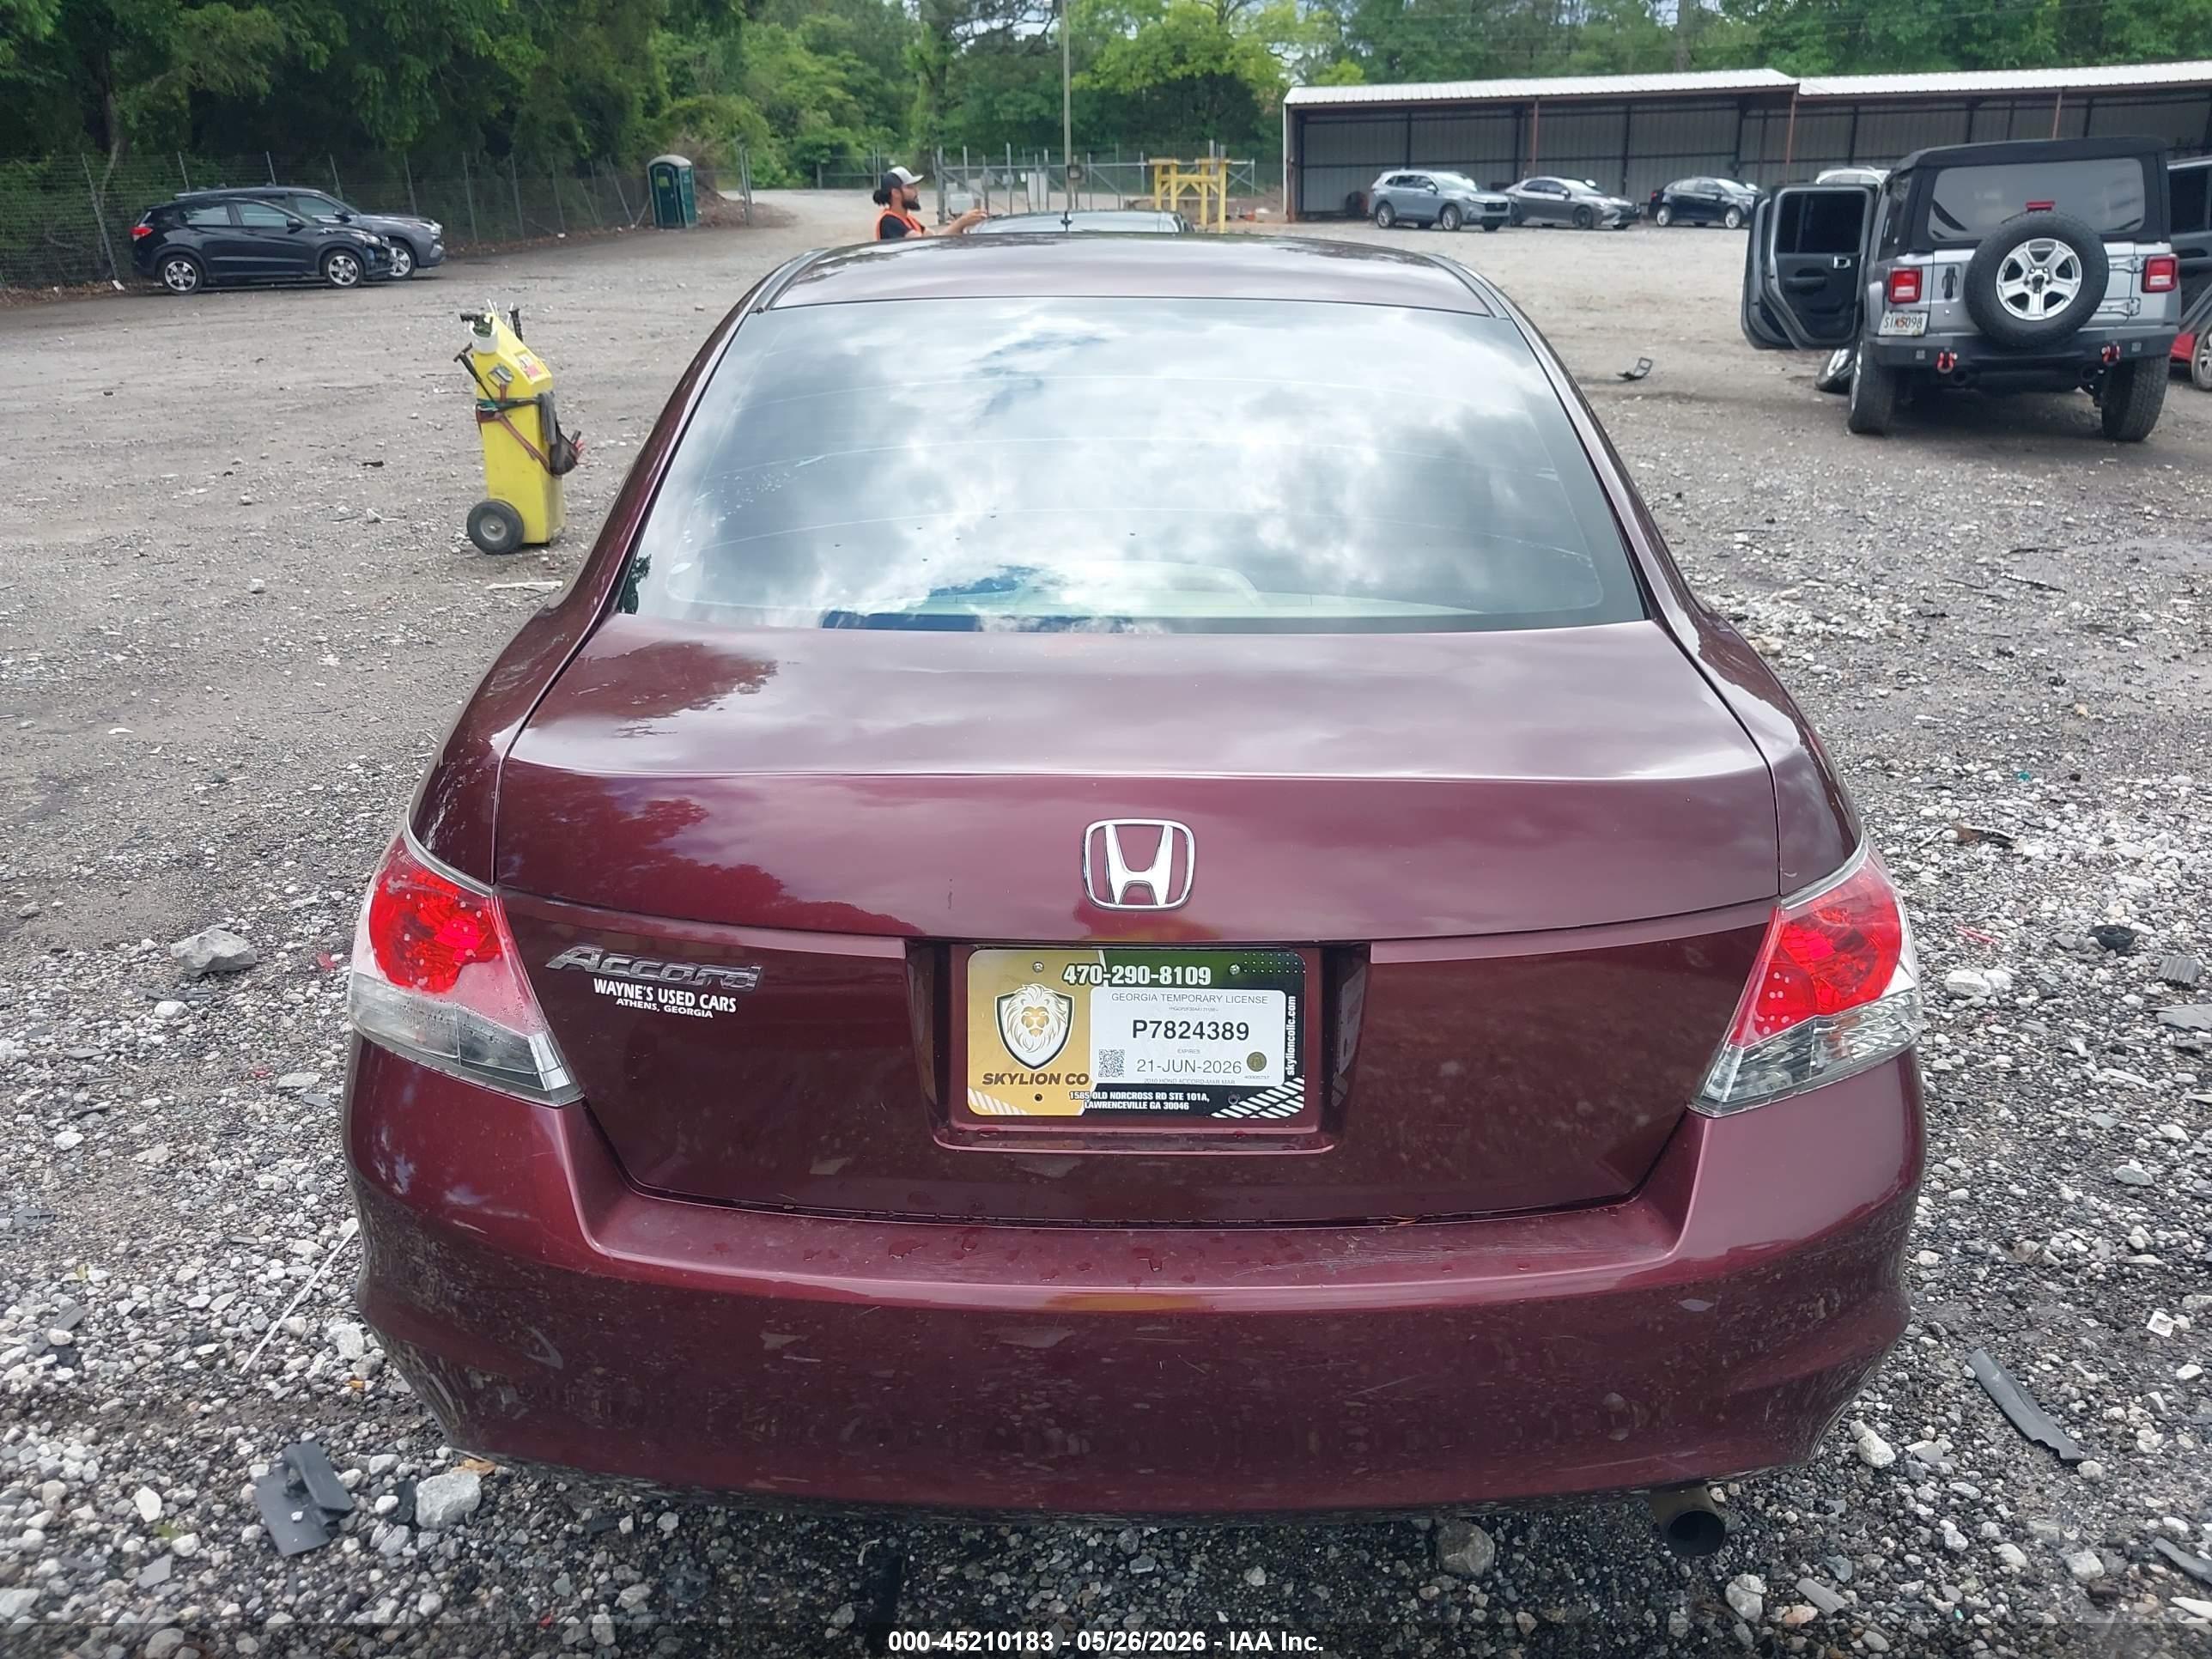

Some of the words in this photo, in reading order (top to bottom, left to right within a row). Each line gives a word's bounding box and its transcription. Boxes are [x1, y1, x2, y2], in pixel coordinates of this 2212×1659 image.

[545, 944, 763, 992] Accord
[1062, 963, 1212, 987] 470-290-8109
[593, 978, 653, 1001] WAYNE'S
[658, 988, 696, 1006] USED
[699, 994, 737, 1013] CARS
[1111, 993, 1158, 1002] GEORGIA
[1161, 994, 1224, 1004] TEMPORARY
[1225, 995, 1268, 1005] LICENSE
[616, 998, 660, 1012] ATHENS,
[664, 1004, 714, 1018] GEORGIA
[1133, 1019, 1250, 1041] P7824389
[1285, 995, 1297, 1077] skylioncollc.com
[1136, 1059, 1242, 1074] 21-JUN-2026
[982, 1073, 1061, 1085] SKYLION
[1065, 1073, 1090, 1085] CO
[1085, 1101, 1148, 1109] LAWRENCEVILLE
[1164, 1102, 1190, 1110] 30046
[1091, 1091, 1108, 1100] OLD
[1109, 1091, 1153, 1100] NORCROSS
[1169, 1092, 1184, 1101] STE
[1187, 1093, 1210, 1103] 101A,
